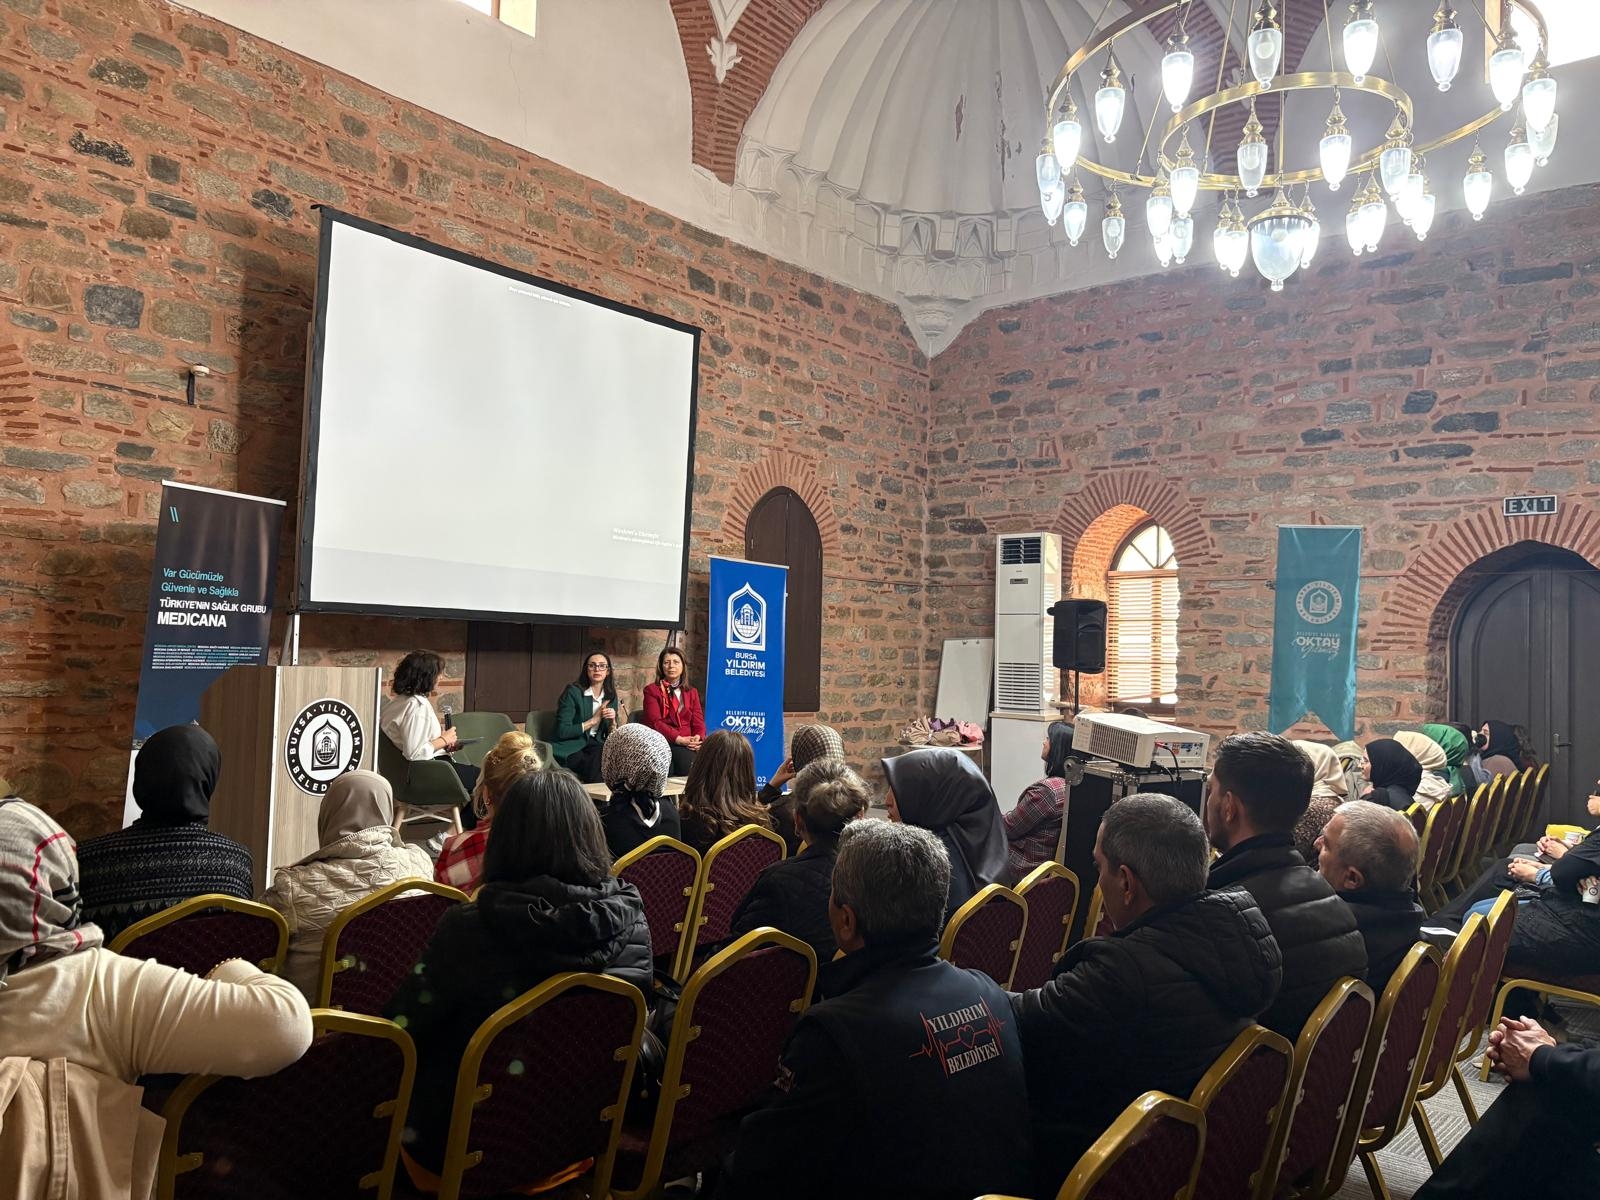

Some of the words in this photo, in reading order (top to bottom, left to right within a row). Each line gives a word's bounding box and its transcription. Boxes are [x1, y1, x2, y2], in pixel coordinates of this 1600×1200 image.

[1509, 498, 1551, 512] EXIT
[163, 568, 177, 578] Var
[179, 569, 224, 582] Gücümüzle
[161, 582, 196, 594] Güvenle
[197, 587, 207, 595] ve
[209, 586, 239, 598] Sağlıkla
[211, 600, 239, 612] SAĞLIK
[240, 604, 267, 614] GRUBU
[157, 611, 227, 627] MEDICANA
[1296, 636, 1340, 648] OKTAY
[735, 651, 757, 660] BURSA
[726, 659, 765, 670] YILDIRIM
[289, 712, 313, 755] BURSA
[319, 703, 361, 746] YILDIRIM
[725, 716, 766, 728] OKTAY
[927, 1003, 988, 1034] YILDIRIM
[946, 1038, 1000, 1074] BELEDİYESİ
